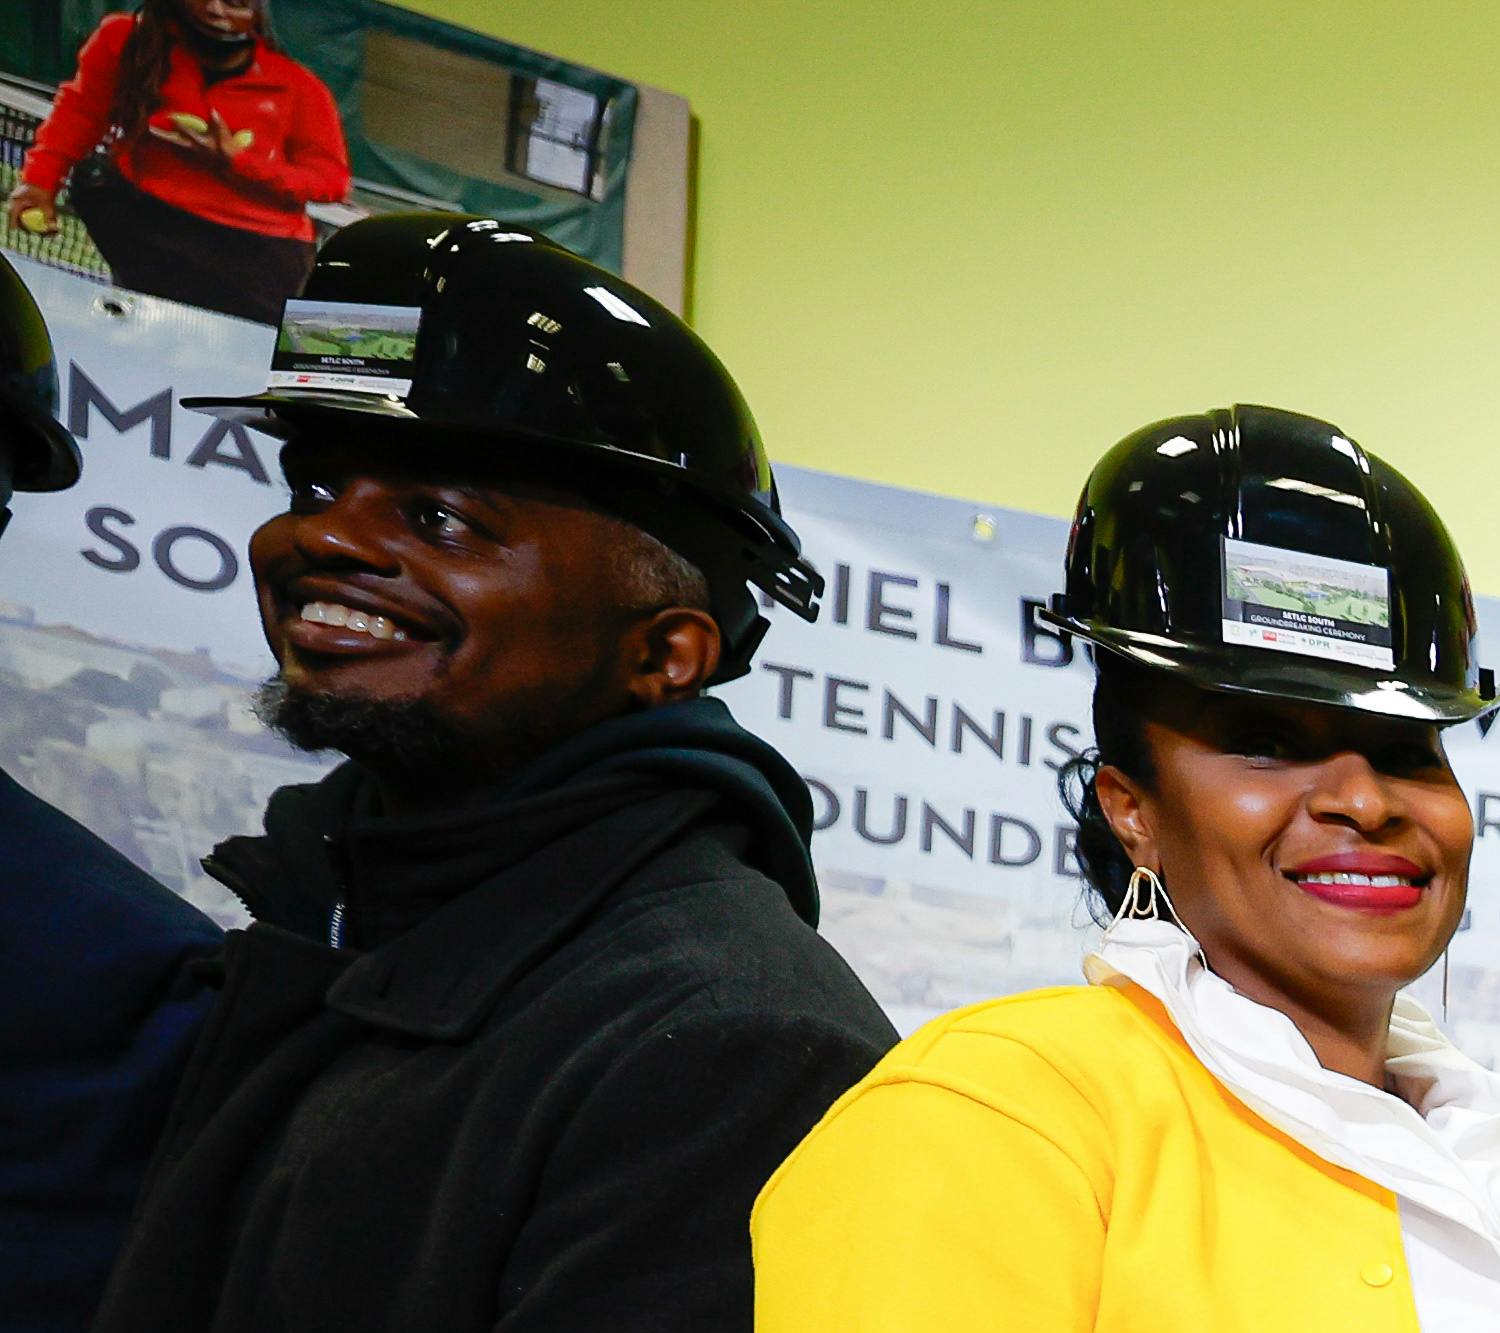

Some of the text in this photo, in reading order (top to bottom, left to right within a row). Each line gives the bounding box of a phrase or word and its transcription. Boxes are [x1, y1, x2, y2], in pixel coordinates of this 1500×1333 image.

[68, 358, 271, 487] MA
[762, 562, 983, 653] IEL
[80, 505, 240, 592] SO
[761, 662, 1081, 771] TENNIS
